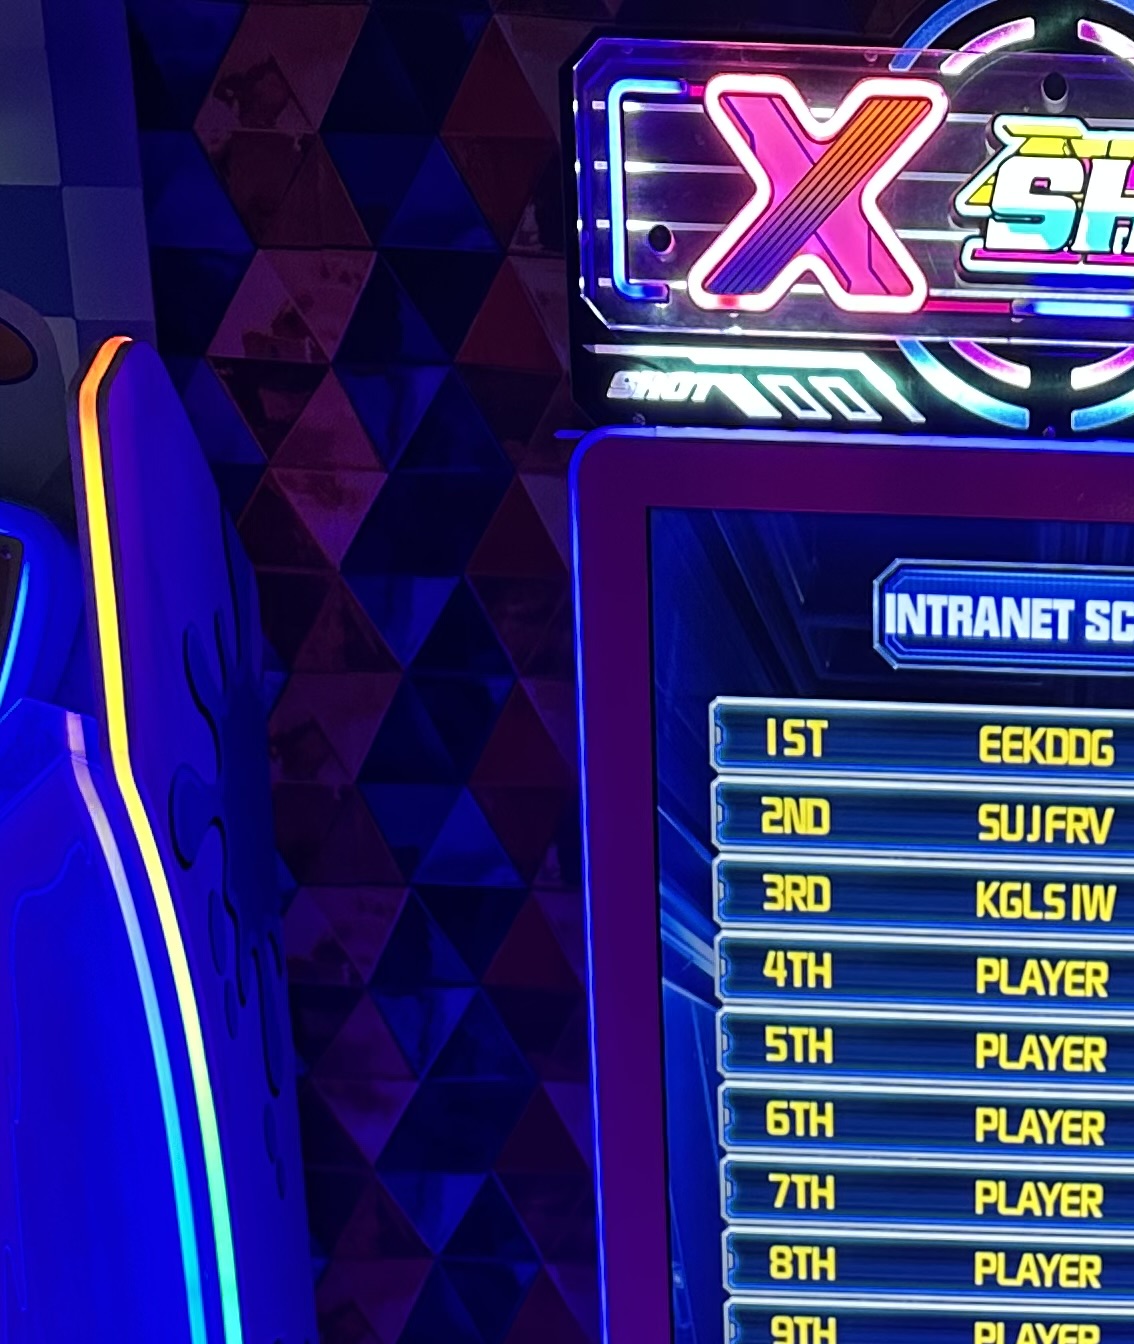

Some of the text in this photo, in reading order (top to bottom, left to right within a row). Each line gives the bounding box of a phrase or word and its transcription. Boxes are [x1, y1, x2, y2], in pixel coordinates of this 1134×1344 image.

[690, 75, 946, 311] X
[607, 370, 712, 402] SHOT
[885, 592, 1076, 643] INTRANET
[767, 718, 828, 757] 1ST
[979, 725, 1115, 767] EEKDDG
[761, 796, 831, 835] 2ND
[978, 803, 1115, 844] SUJFRV
[763, 873, 831, 913] 3RD
[763, 950, 832, 988] 4TH
[976, 957, 1109, 997] PLAYER
[765, 1025, 833, 1063] 5TH
[976, 1033, 1107, 1072] PLAYER
[766, 1100, 834, 1137] 6TH
[975, 1107, 1105, 1145] PLAYER
[769, 1173, 835, 1209] 7TH
[975, 1180, 1104, 1218] PLAYER
[769, 1245, 836, 1280] 8TH
[974, 1251, 1102, 1288] PLAYER
